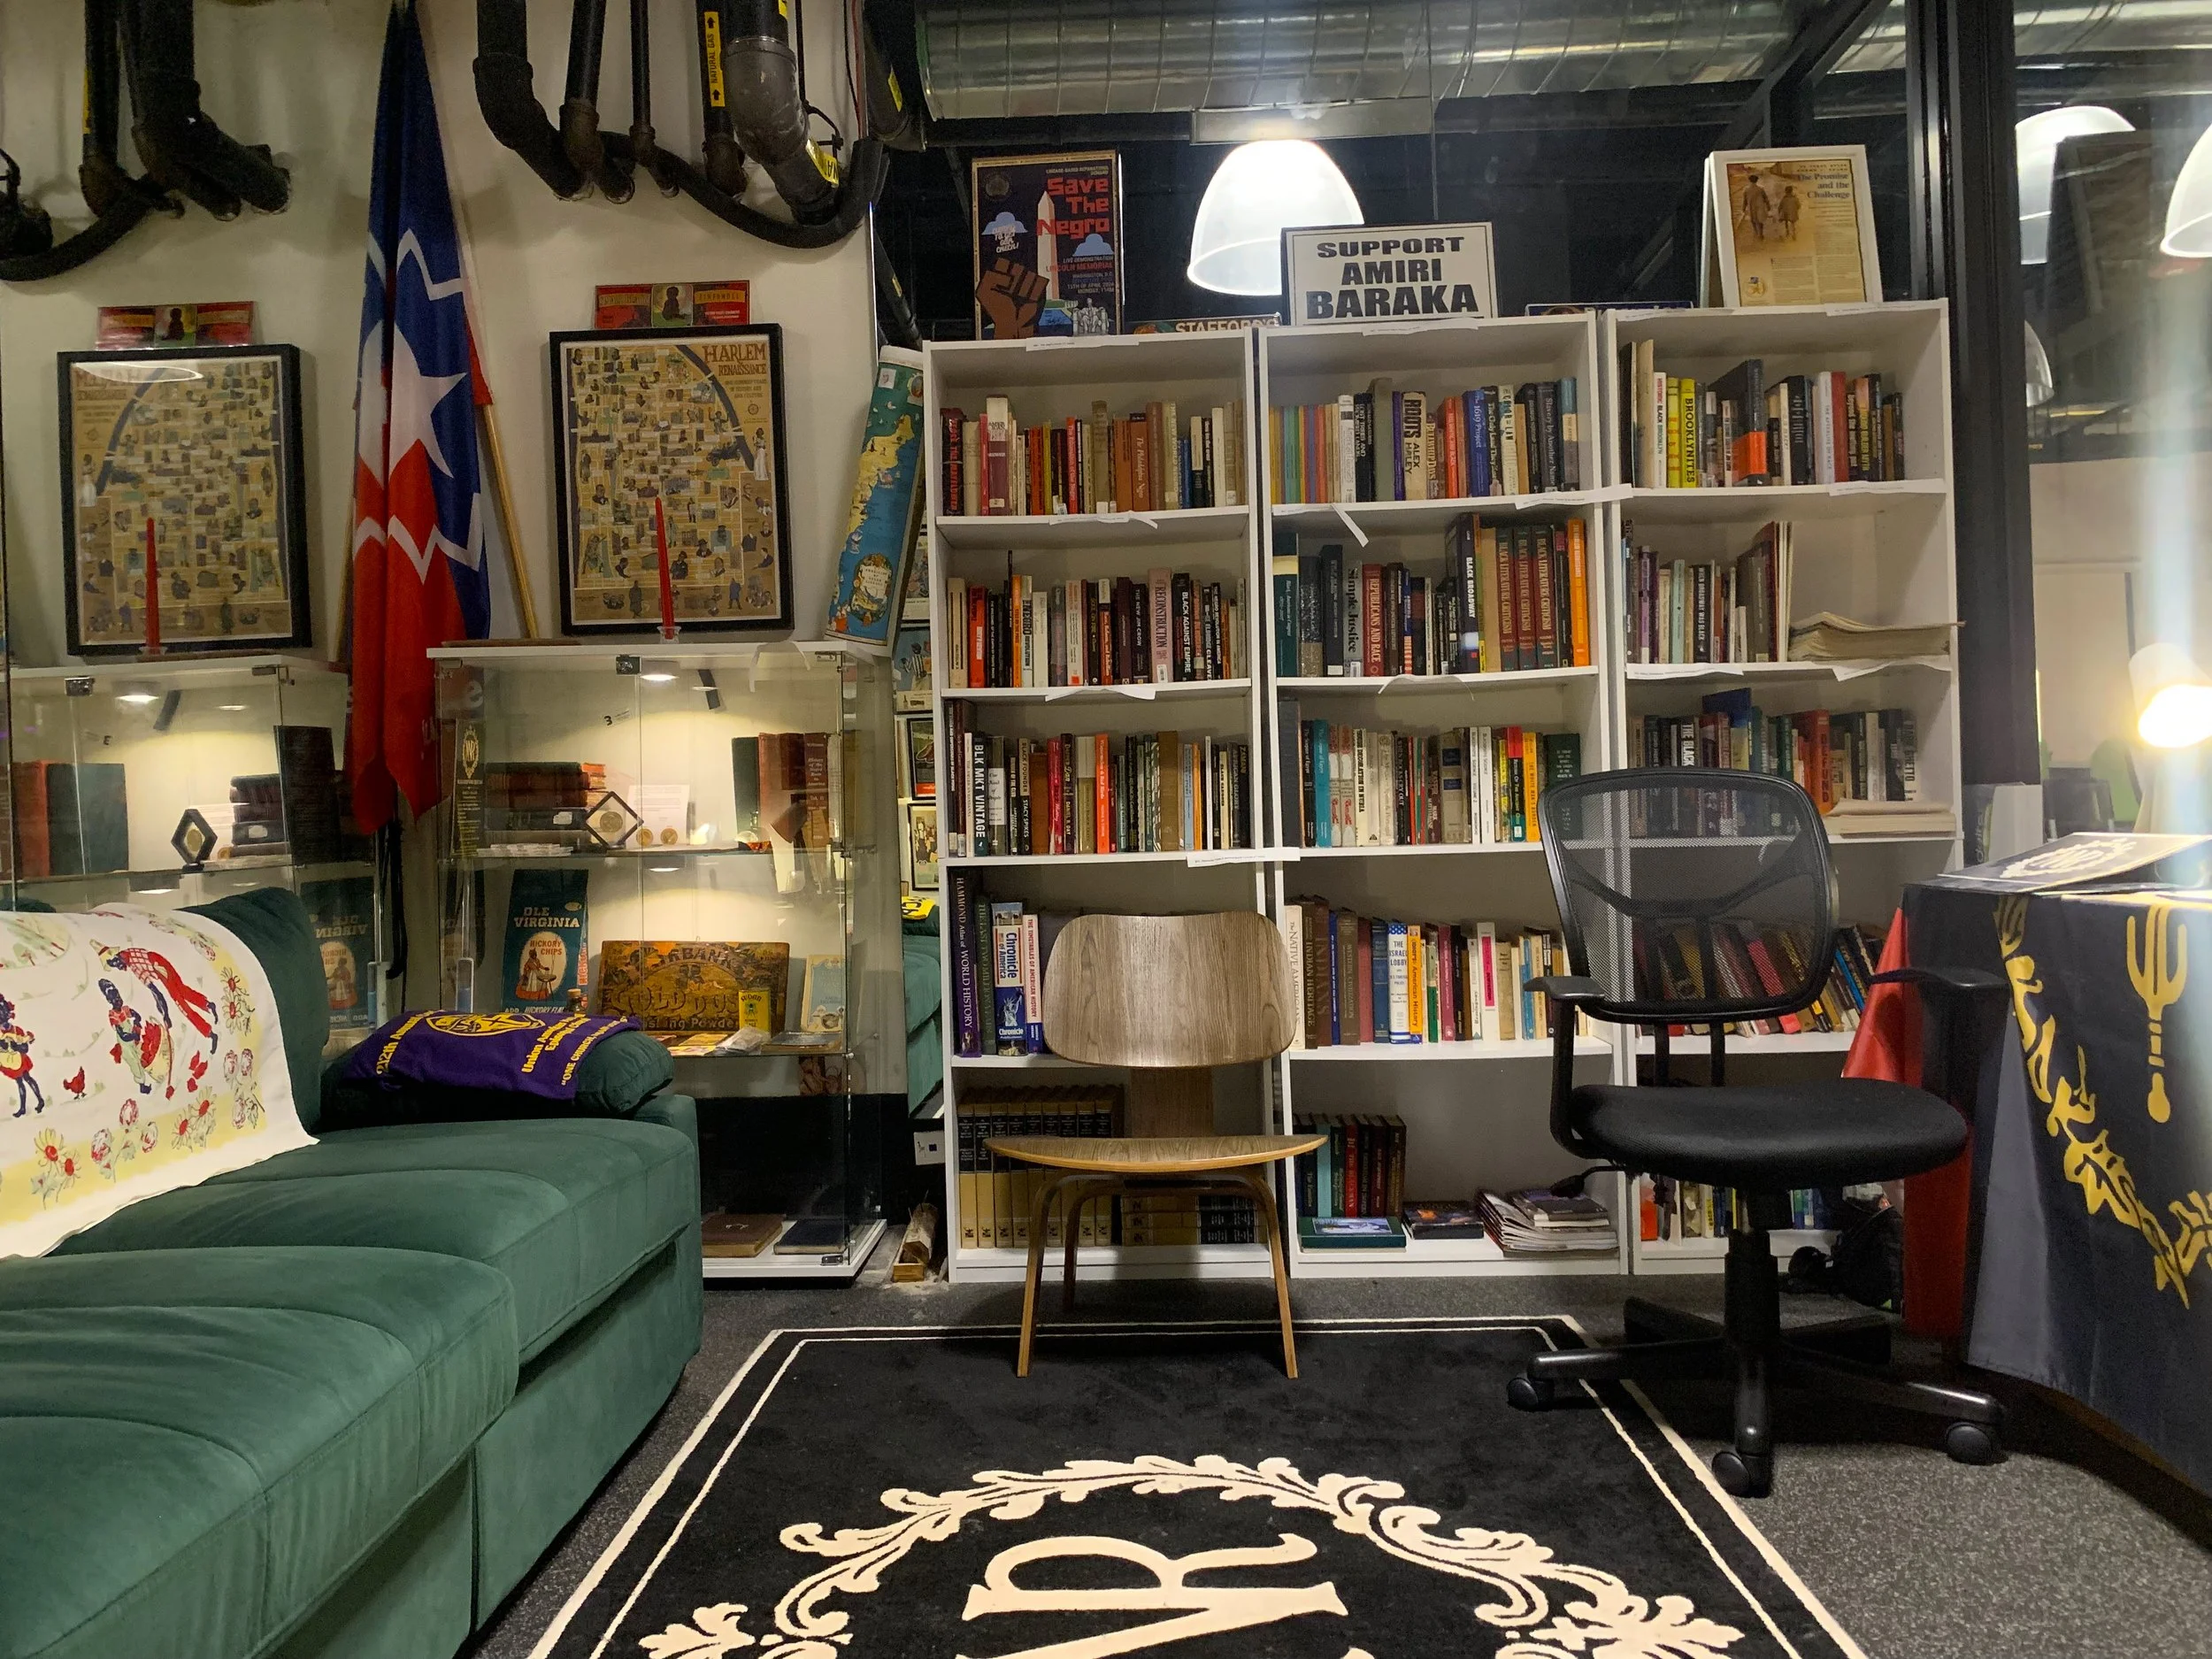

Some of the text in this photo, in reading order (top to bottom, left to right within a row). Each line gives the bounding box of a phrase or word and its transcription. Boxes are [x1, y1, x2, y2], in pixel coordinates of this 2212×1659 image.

[709, 51, 718, 83] NATURAL
[1048, 177, 1109, 196] Save
[1066, 196, 1110, 214] The
[1037, 218, 1110, 240] Negro
[1317, 236, 1465, 258] SUPPORT
[1341, 258, 1442, 285] AMIRI
[1306, 284, 1479, 319] BARAKA
[703, 343, 767, 366] HARLEM
[718, 364, 767, 377] RENAISSANCE
[1403, 399, 1422, 438] ROOTS
[1472, 405, 1481, 423] 1619
[1503, 395, 1512, 419] COLOR
[1545, 398, 1554, 423] Slavery
[1847, 395, 1856, 418] beyond
[1486, 416, 1495, 432] Only
[1426, 423, 1437, 480] BULLWHIP DAYS
[1547, 435, 1555, 464] Another
[1685, 397, 1695, 482] BROOKLYNITES
[1847, 431, 1856, 455] melting
[1136, 449, 1145, 481] Philadelphia
[1488, 449, 1497, 464] They
[1849, 457, 1858, 467] pot
[950, 446, 959, 510] THE MAYFLOWER
[1137, 483, 1146, 499] Negro
[1467, 580, 1476, 618] BROADWAY
[1499, 541, 1512, 634] BLACK LITERATURE CRITICISM
[1518, 540, 1532, 632] BLACK LITERATURE CRITICISM
[1536, 538, 1552, 630] BLACK LITERATURE CRITICISM
[1023, 605, 1032, 635] NEGRO
[1155, 588, 1167, 648] RECONSTRUCTION
[1347, 568, 1360, 653] Simple Justice
[1370, 579, 1381, 663] REPUBLICANS AND RACE
[603, 715, 613, 726] 3
[1683, 724, 1695, 766] THE BLACK
[1904, 725, 1915, 782] DARK GHETTO
[974, 744, 986, 837] BLK MKT VINTAGE
[524, 907, 549, 917] OLE
[956, 878, 966, 924] HAMMOND
[514, 917, 580, 927] VIRGINIA
[979, 921, 988, 942] LAST
[980, 945, 989, 966] TWO
[1006, 933, 1019, 979] Chronicle
[1288, 931, 1299, 965] NATIVE
[961, 950, 970, 986] WORLD
[998, 950, 1007, 979] America
[1316, 937, 1329, 1014] INDIANS
[963, 987, 972, 1028] HISTORY
[692, 1018, 738, 1029] Powde
[376, 1041, 399, 1075] 212th
[521, 1044, 544, 1073] Union
[561, 1062, 577, 1087] "ONE
[570, 1036, 597, 1062] CHURCH,
